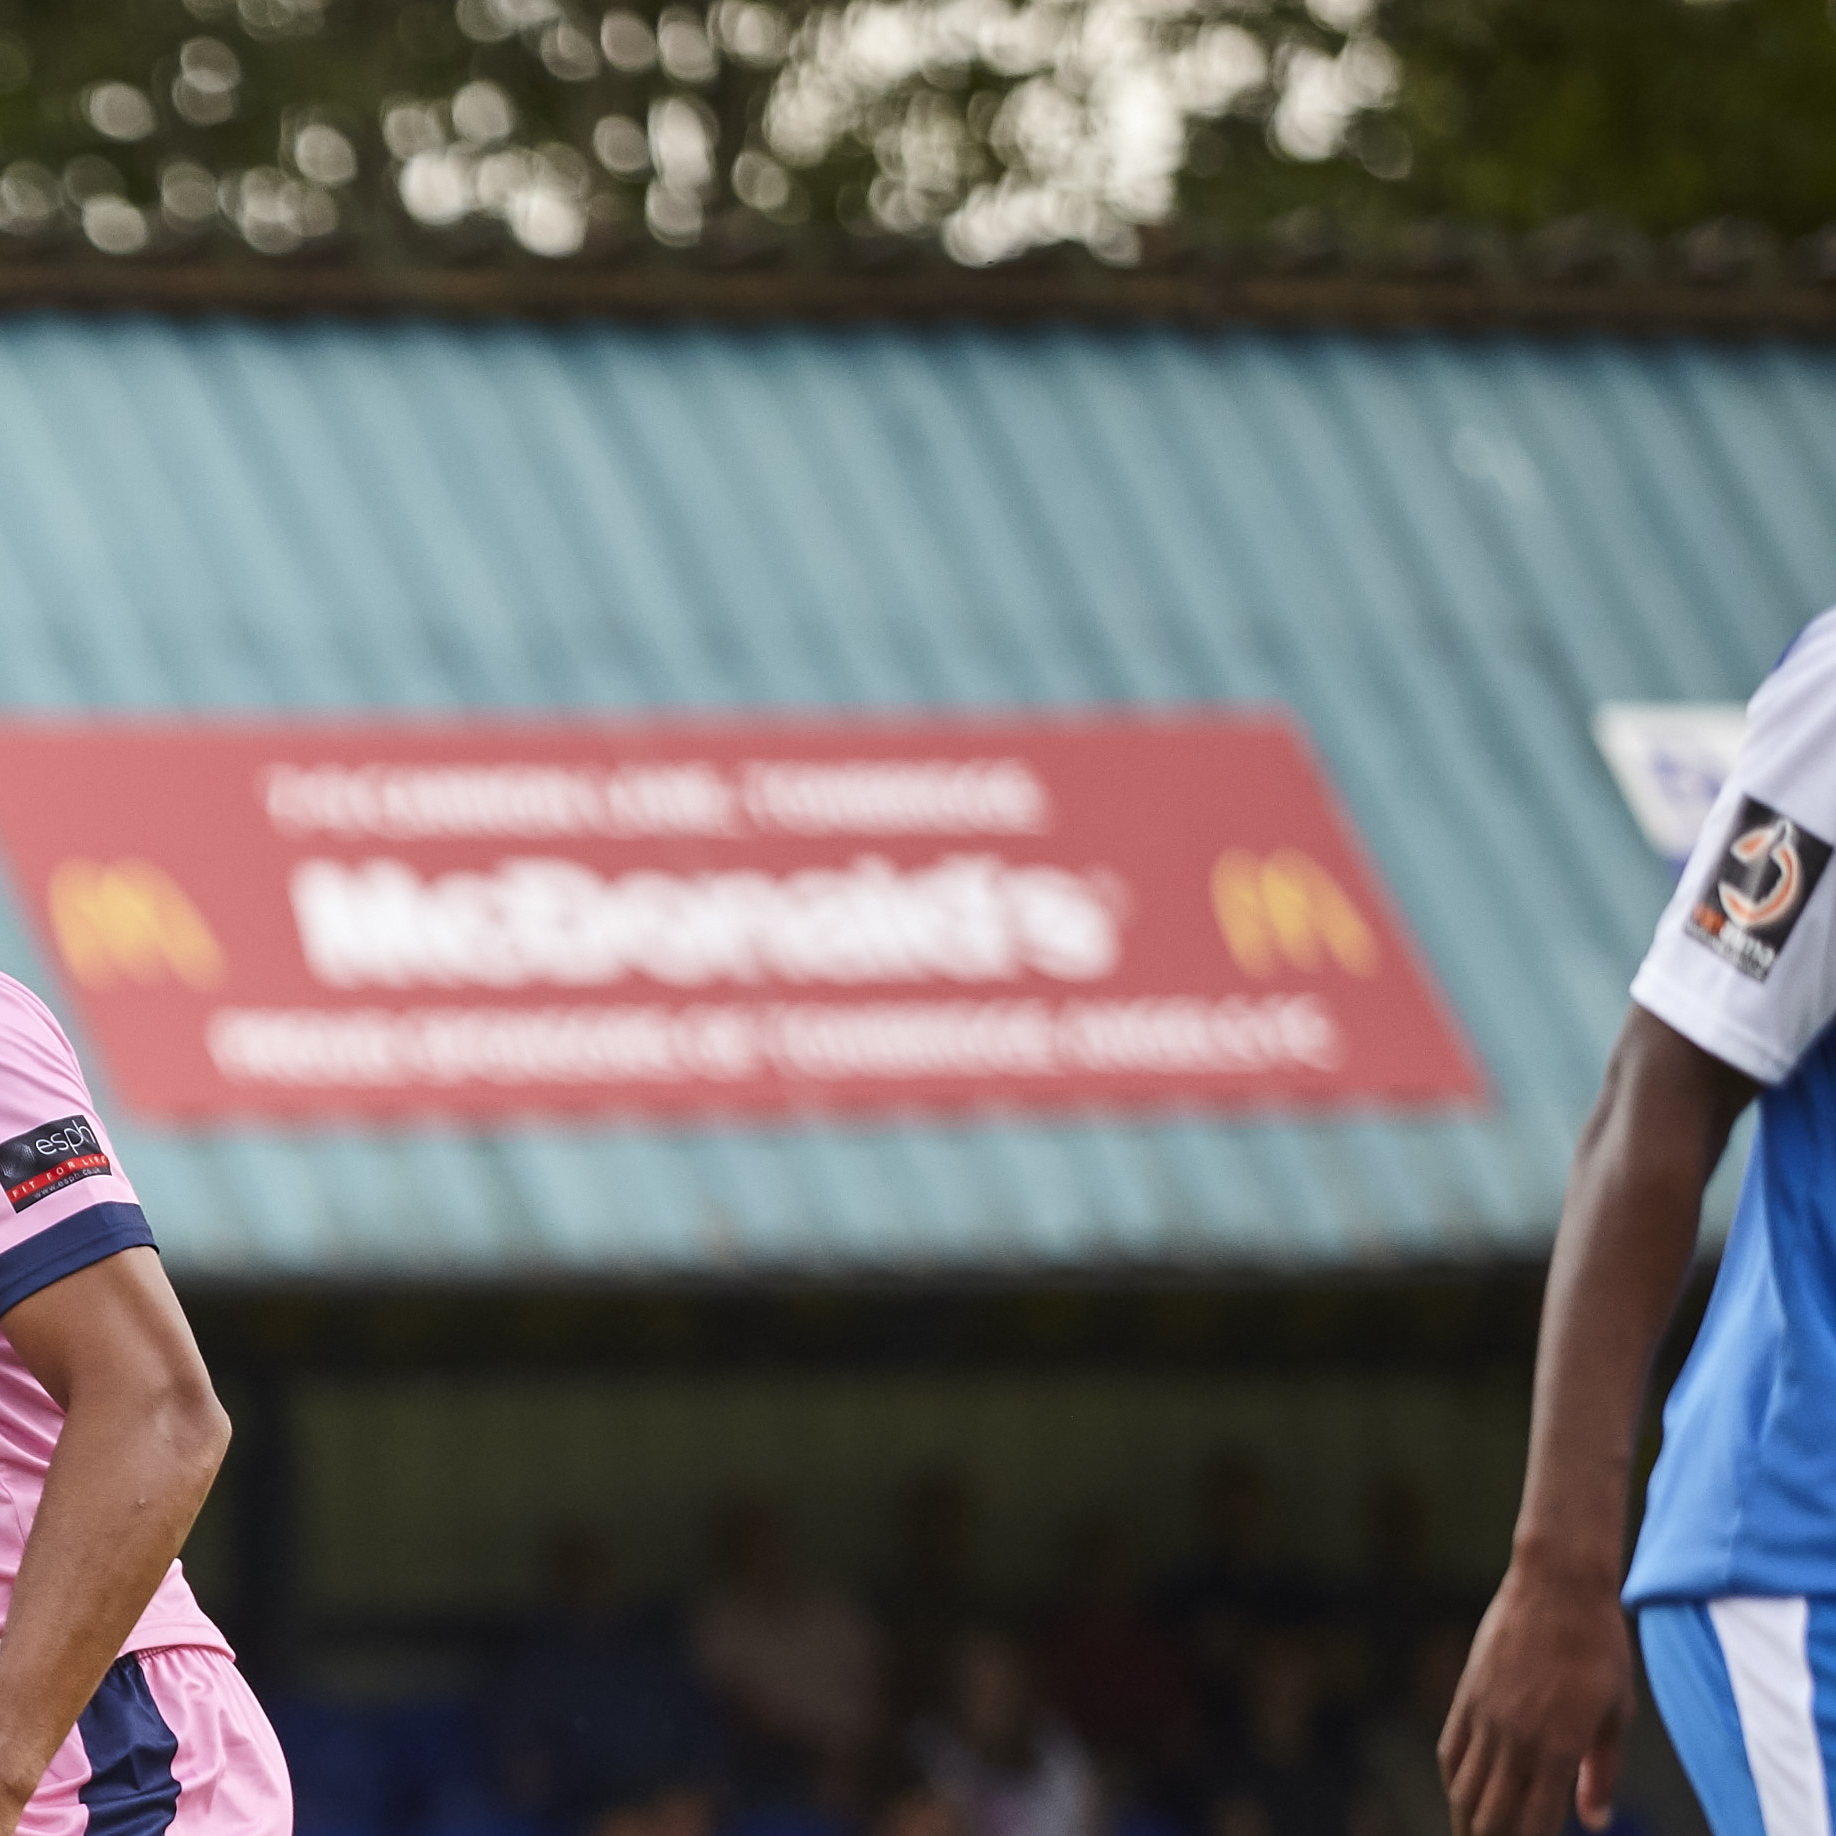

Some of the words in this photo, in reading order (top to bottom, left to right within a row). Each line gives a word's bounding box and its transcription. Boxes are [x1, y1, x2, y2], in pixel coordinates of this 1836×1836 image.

[35, 1119, 96, 1155] esph
[11, 1180, 35, 1199] FIT
[46, 1162, 76, 1181] FOR
